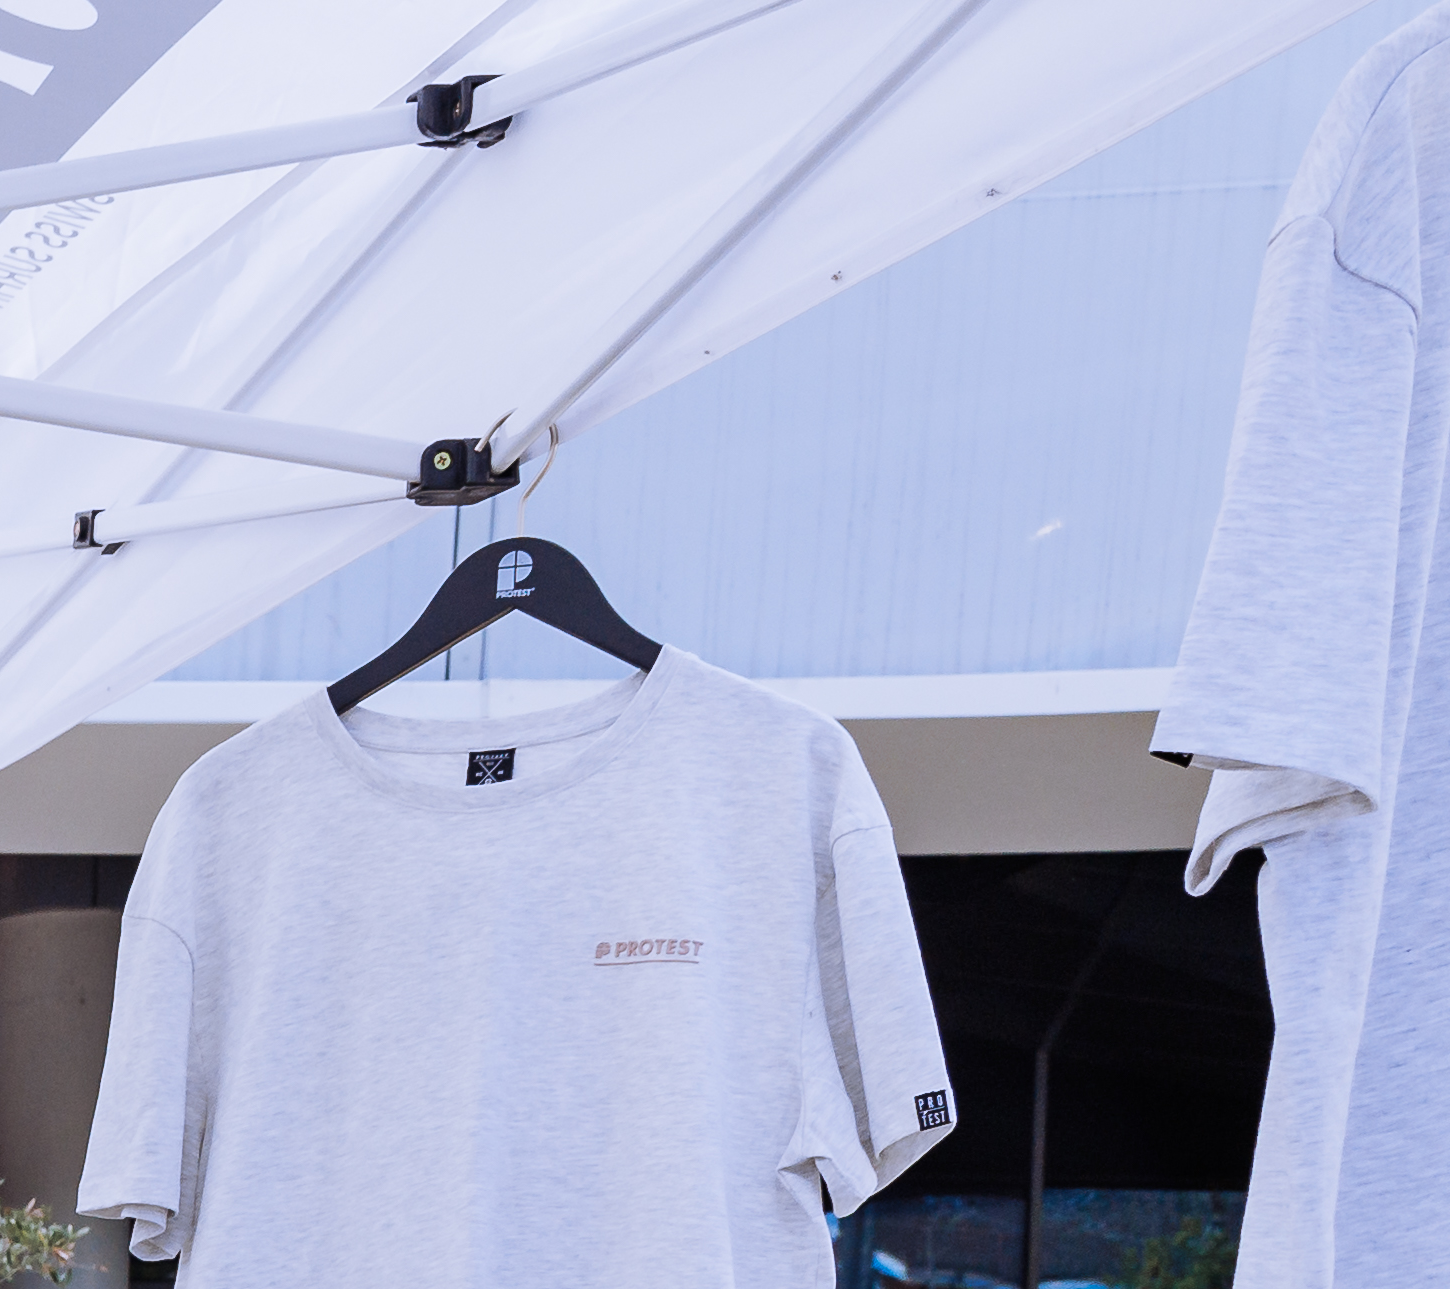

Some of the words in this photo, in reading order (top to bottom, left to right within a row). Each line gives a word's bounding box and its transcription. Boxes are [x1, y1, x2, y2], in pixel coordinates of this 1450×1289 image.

[614, 937, 704, 959] PROTEST
[918, 1094, 944, 1112] PRO
[920, 1110, 947, 1127] TEST
